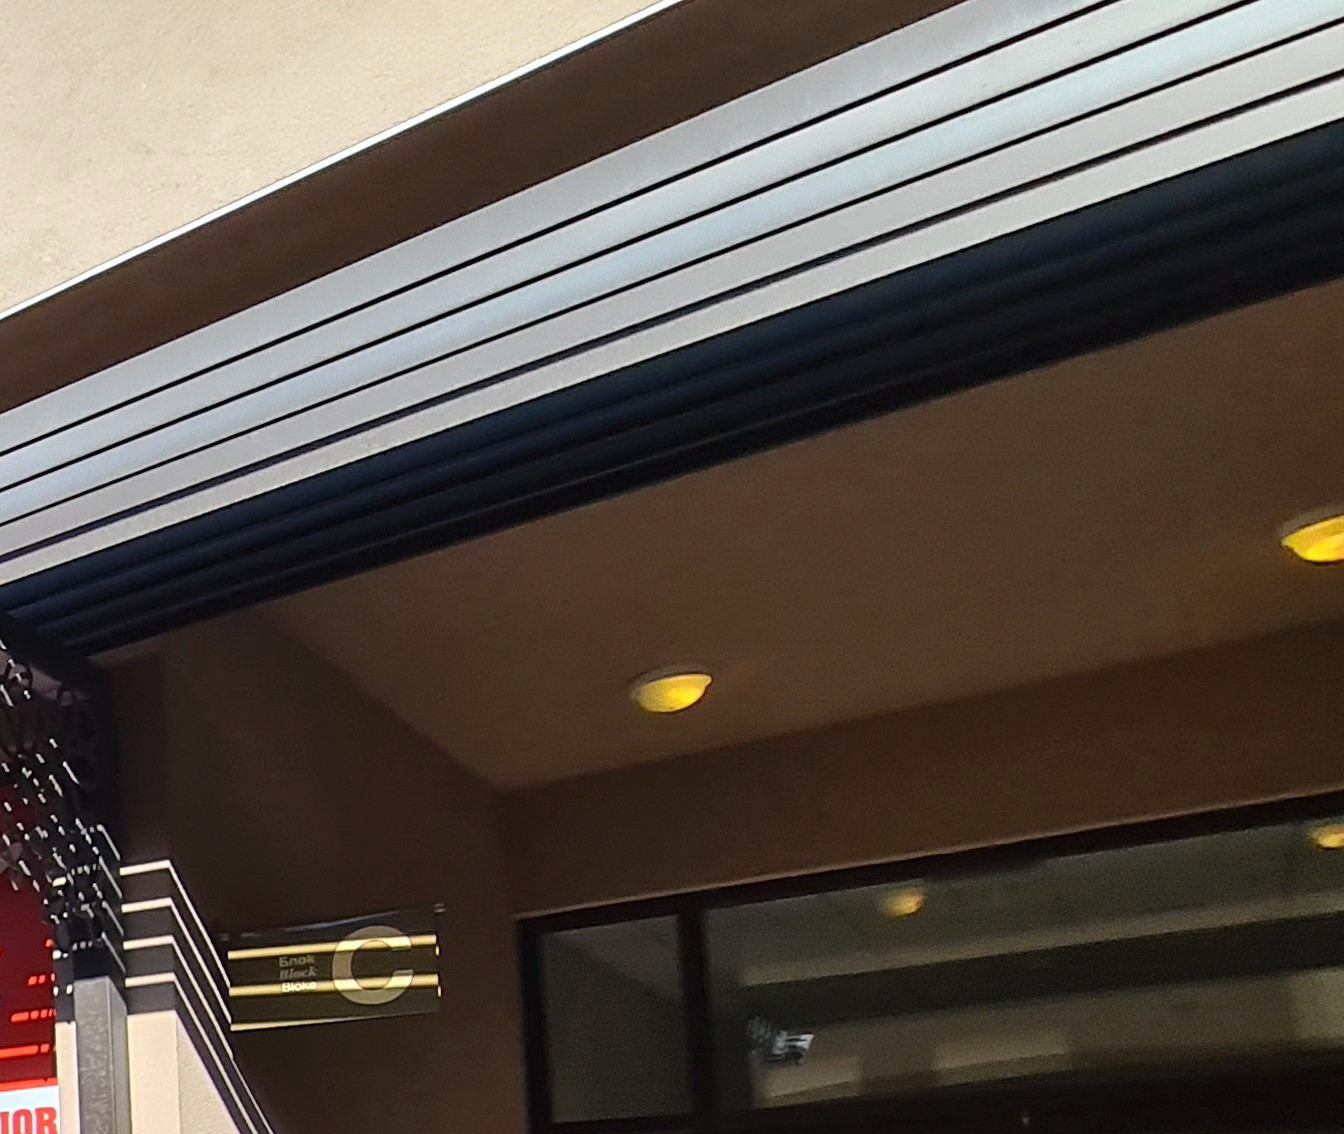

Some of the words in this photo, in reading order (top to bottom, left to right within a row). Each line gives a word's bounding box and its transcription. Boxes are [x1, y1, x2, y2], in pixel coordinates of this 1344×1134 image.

[278, 955, 316, 968] Блок
[331, 925, 414, 1006] C
[278, 966, 318, 980] Block
